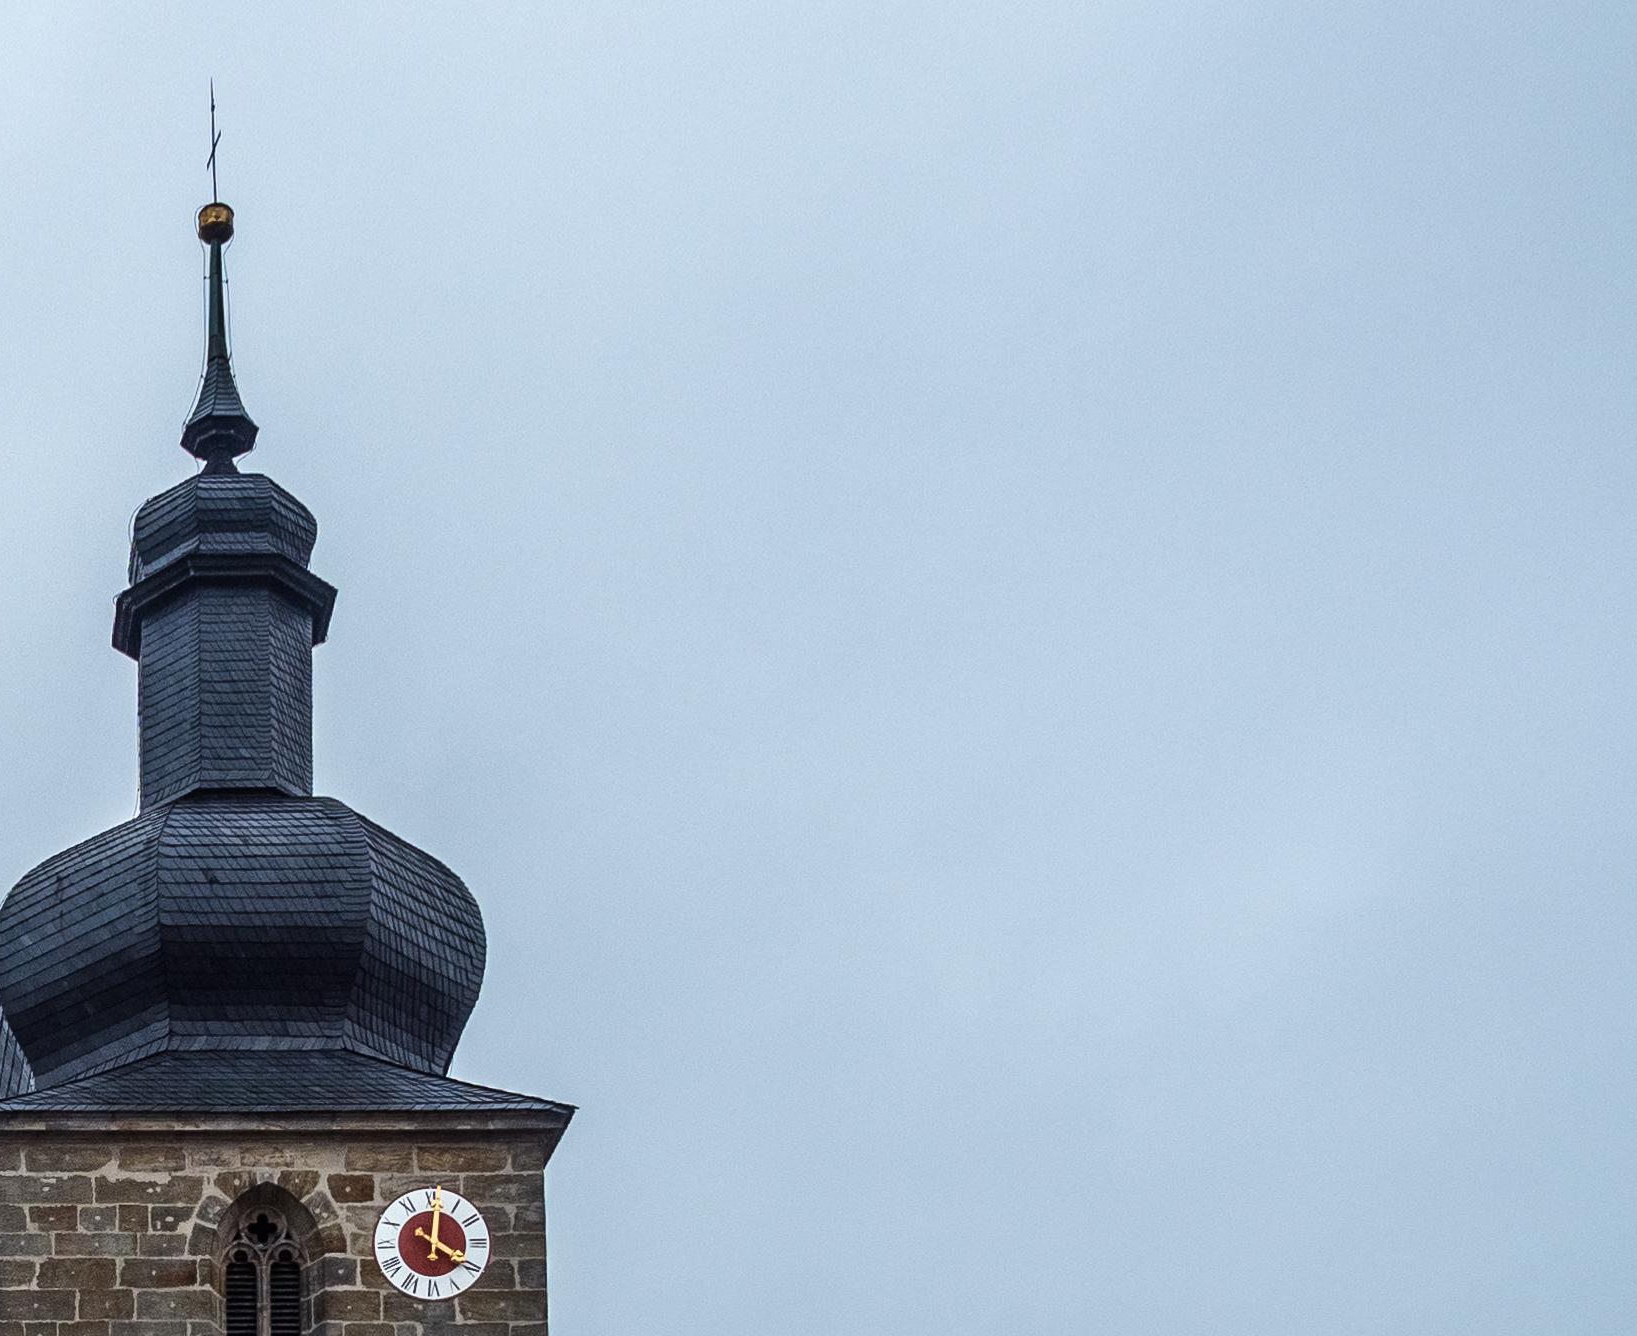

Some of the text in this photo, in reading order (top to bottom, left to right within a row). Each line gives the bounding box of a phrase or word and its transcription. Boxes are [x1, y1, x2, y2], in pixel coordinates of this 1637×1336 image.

[461, 1213, 481, 1228] II
[468, 1238, 487, 1248] III
[381, 1256, 402, 1278] VIII
[400, 1272, 419, 1294] VII
[427, 1279, 441, 1297] VI
